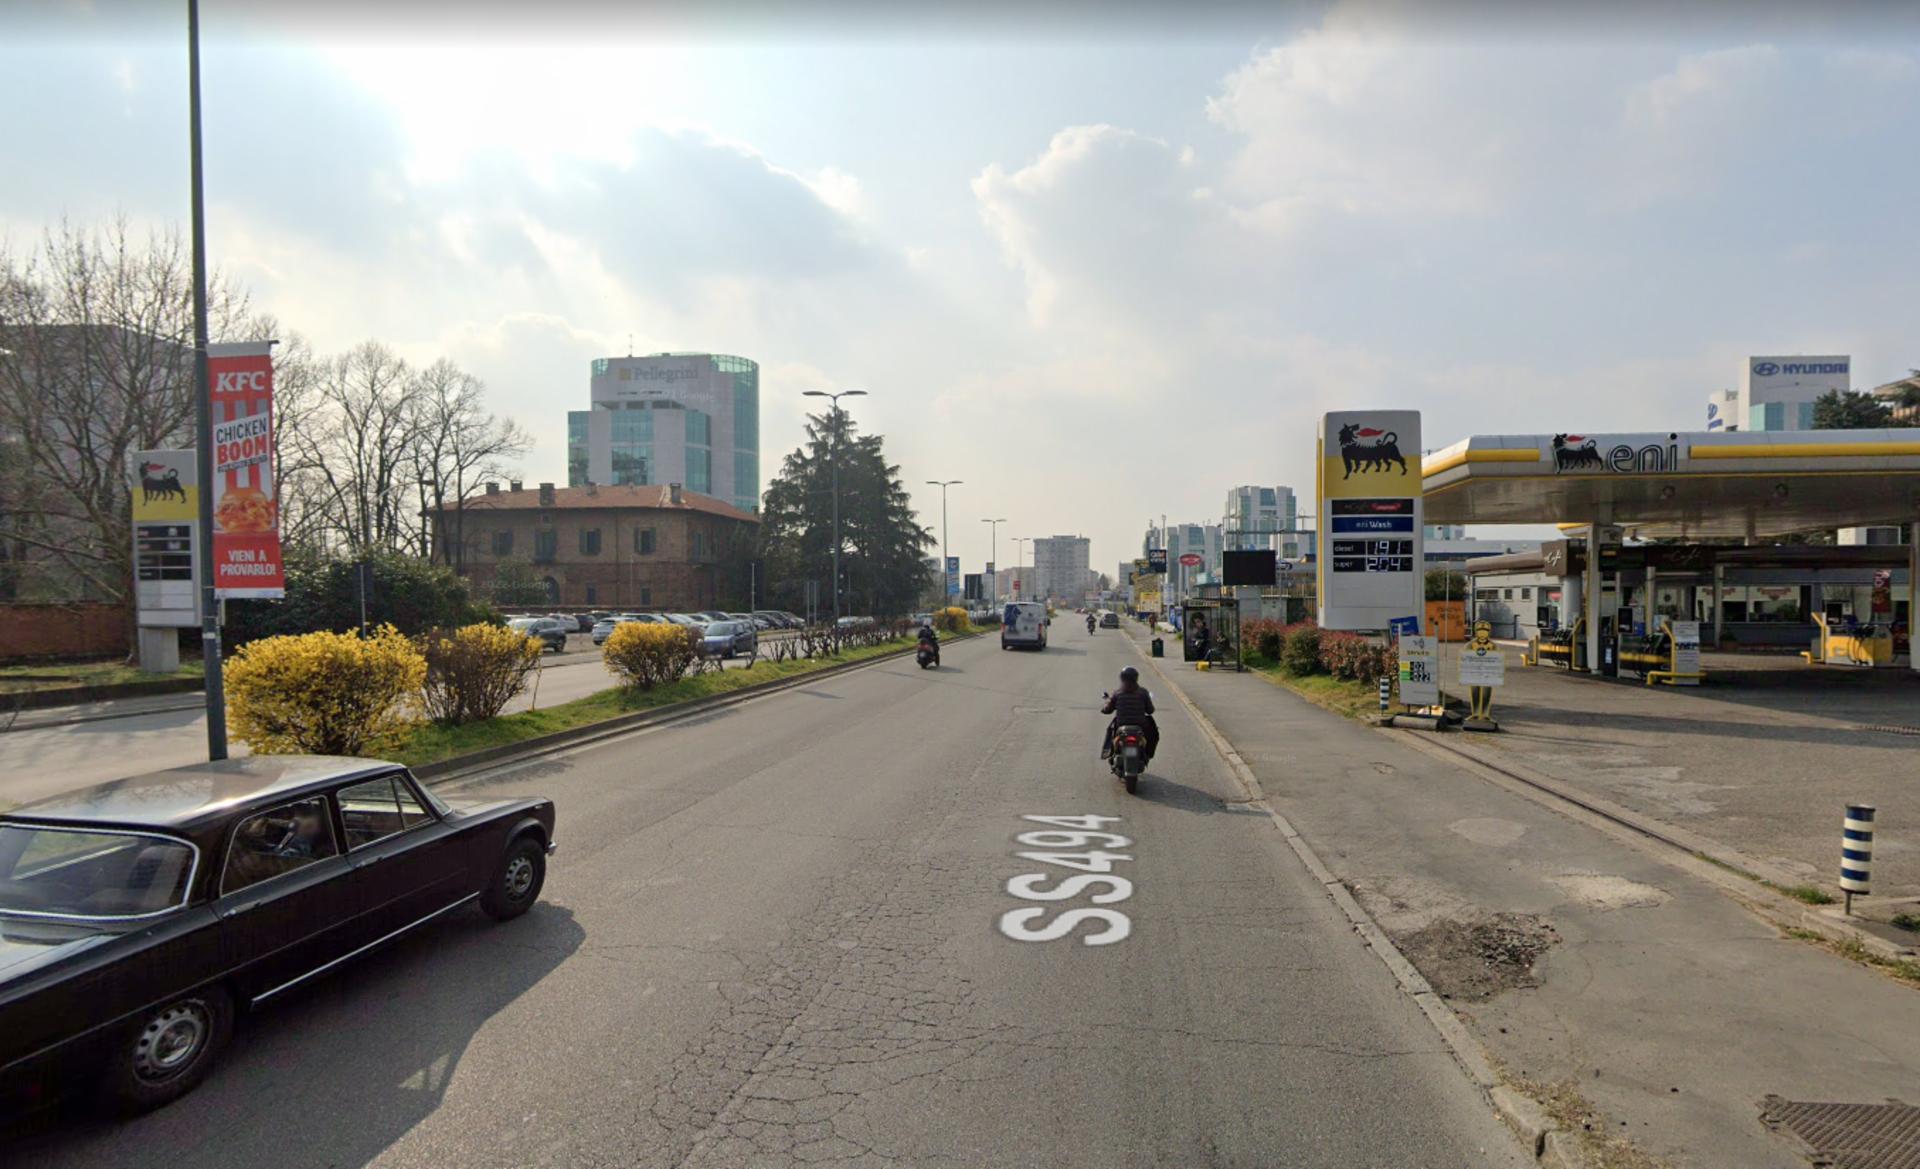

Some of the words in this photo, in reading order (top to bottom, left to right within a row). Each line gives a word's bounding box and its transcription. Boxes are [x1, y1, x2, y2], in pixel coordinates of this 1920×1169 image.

[634, 366, 699, 383] Pellegrini
[1782, 363, 1849, 374] HYUNDAI
[216, 371, 266, 392] KFC
[216, 417, 267, 444] CHICKEN
[217, 434, 267, 465] BOOM
[1607, 432, 1678, 472] eni
[228, 550, 256, 562] VIENI
[258, 549, 267, 562] A
[220, 563, 277, 576] PROVARLO!
[1001, 814, 1134, 946] SS494
